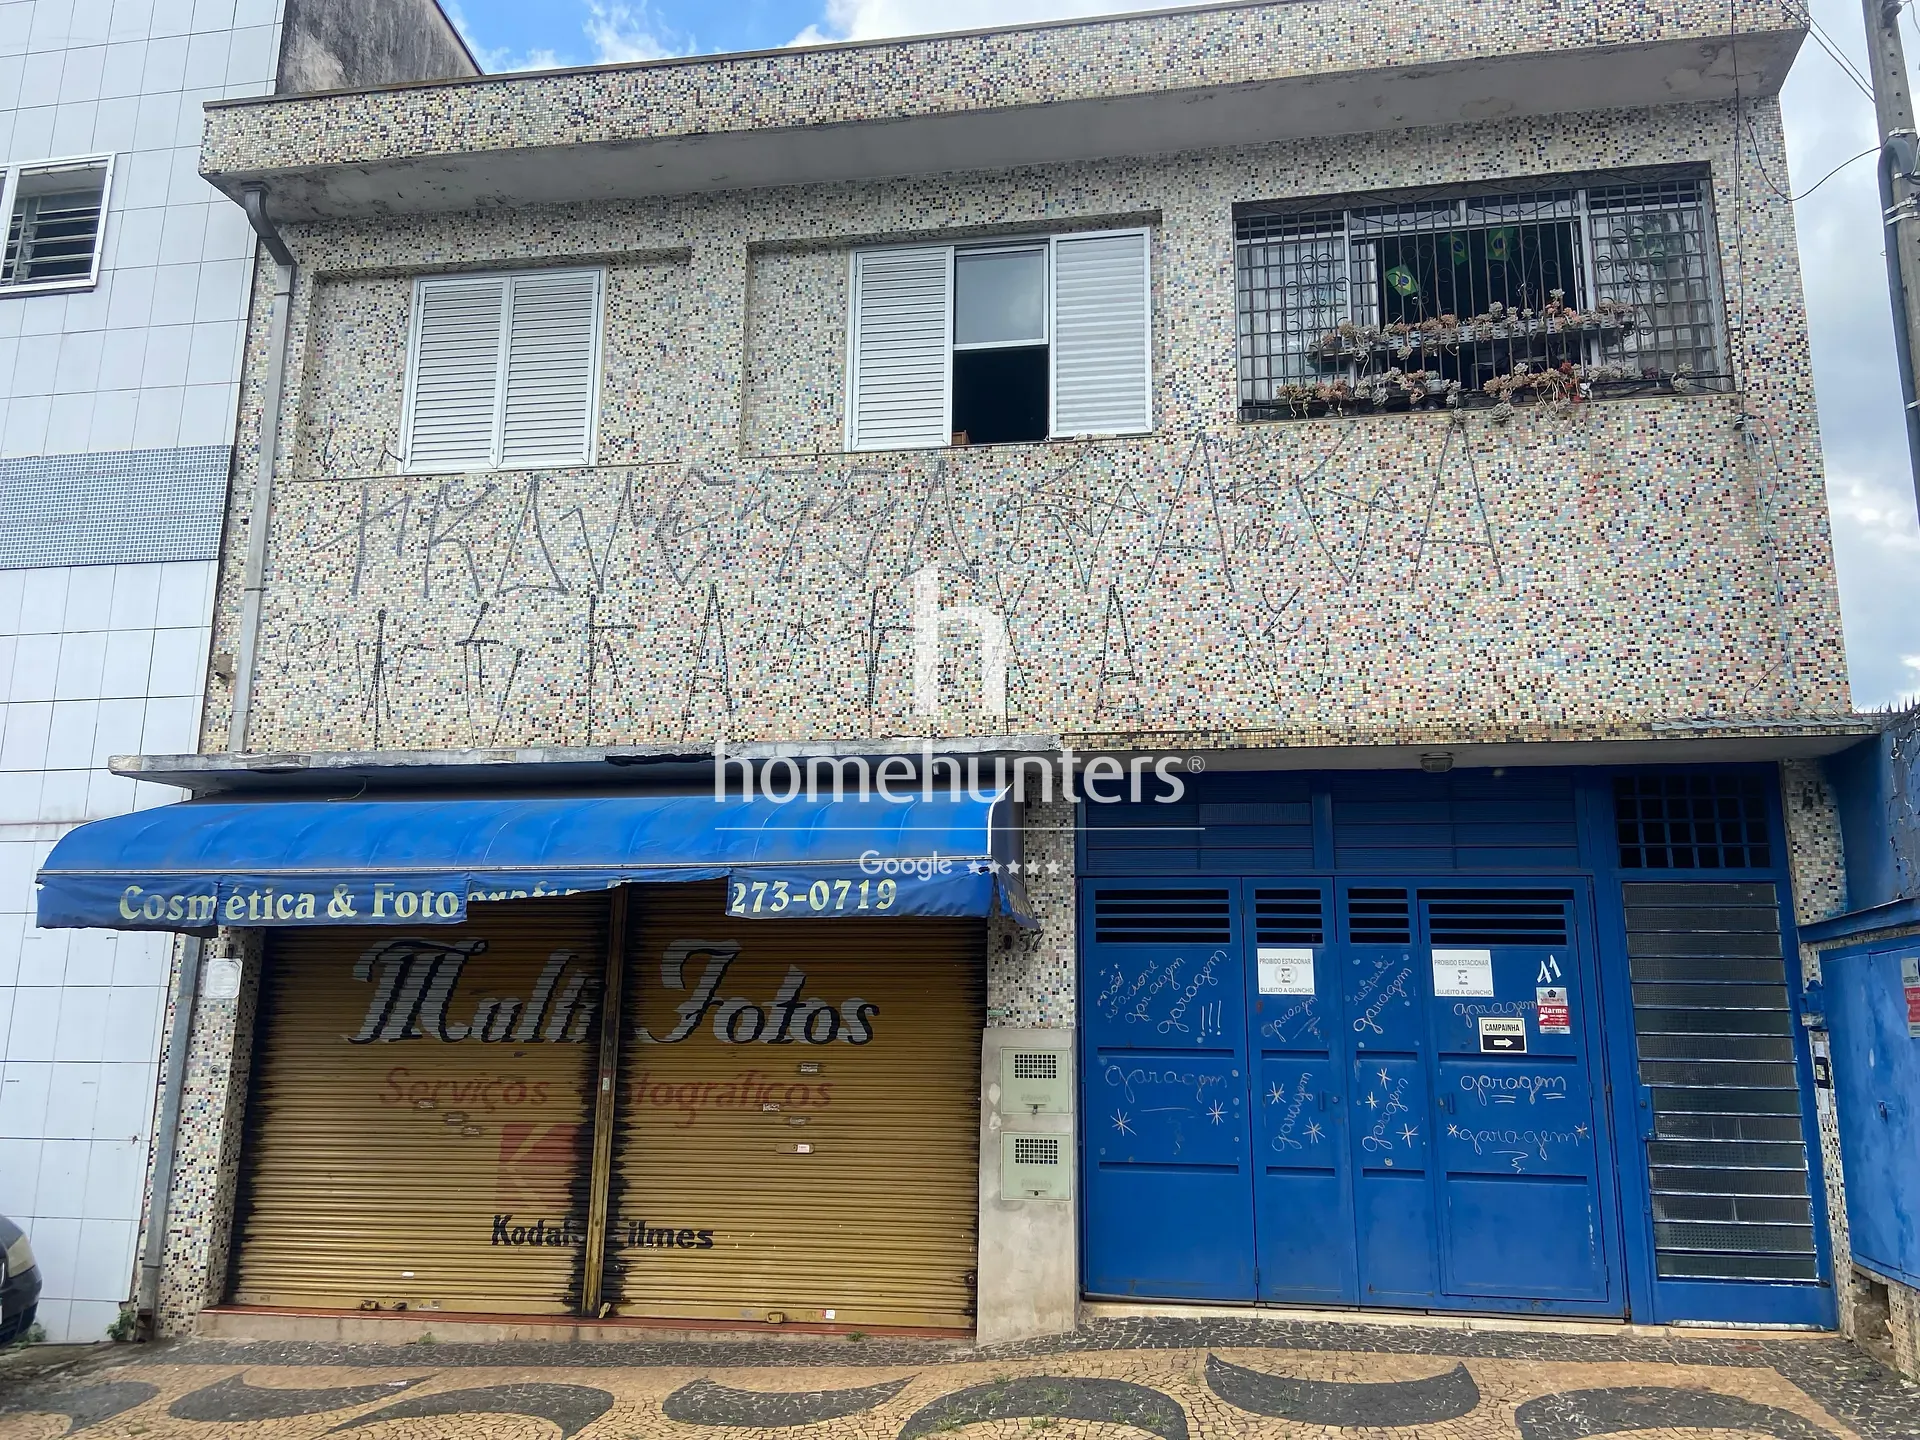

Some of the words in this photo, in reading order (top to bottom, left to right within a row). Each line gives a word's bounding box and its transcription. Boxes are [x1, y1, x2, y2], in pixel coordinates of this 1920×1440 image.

[119, 884, 315, 920] Cosmética
[327, 883, 357, 917] &
[731, 878, 897, 914] 273-0719
[1259, 957, 1281, 965] PROIBIDO
[1281, 957, 1312, 965] ESTACIONAR
[634, 938, 881, 1045] Fotos
[1540, 1006, 1567, 1014] Alarme
[1484, 1023, 1521, 1032] CAMPAINHA
[379, 1066, 552, 1113] Serviços
[618, 1219, 715, 1250] ilmes
